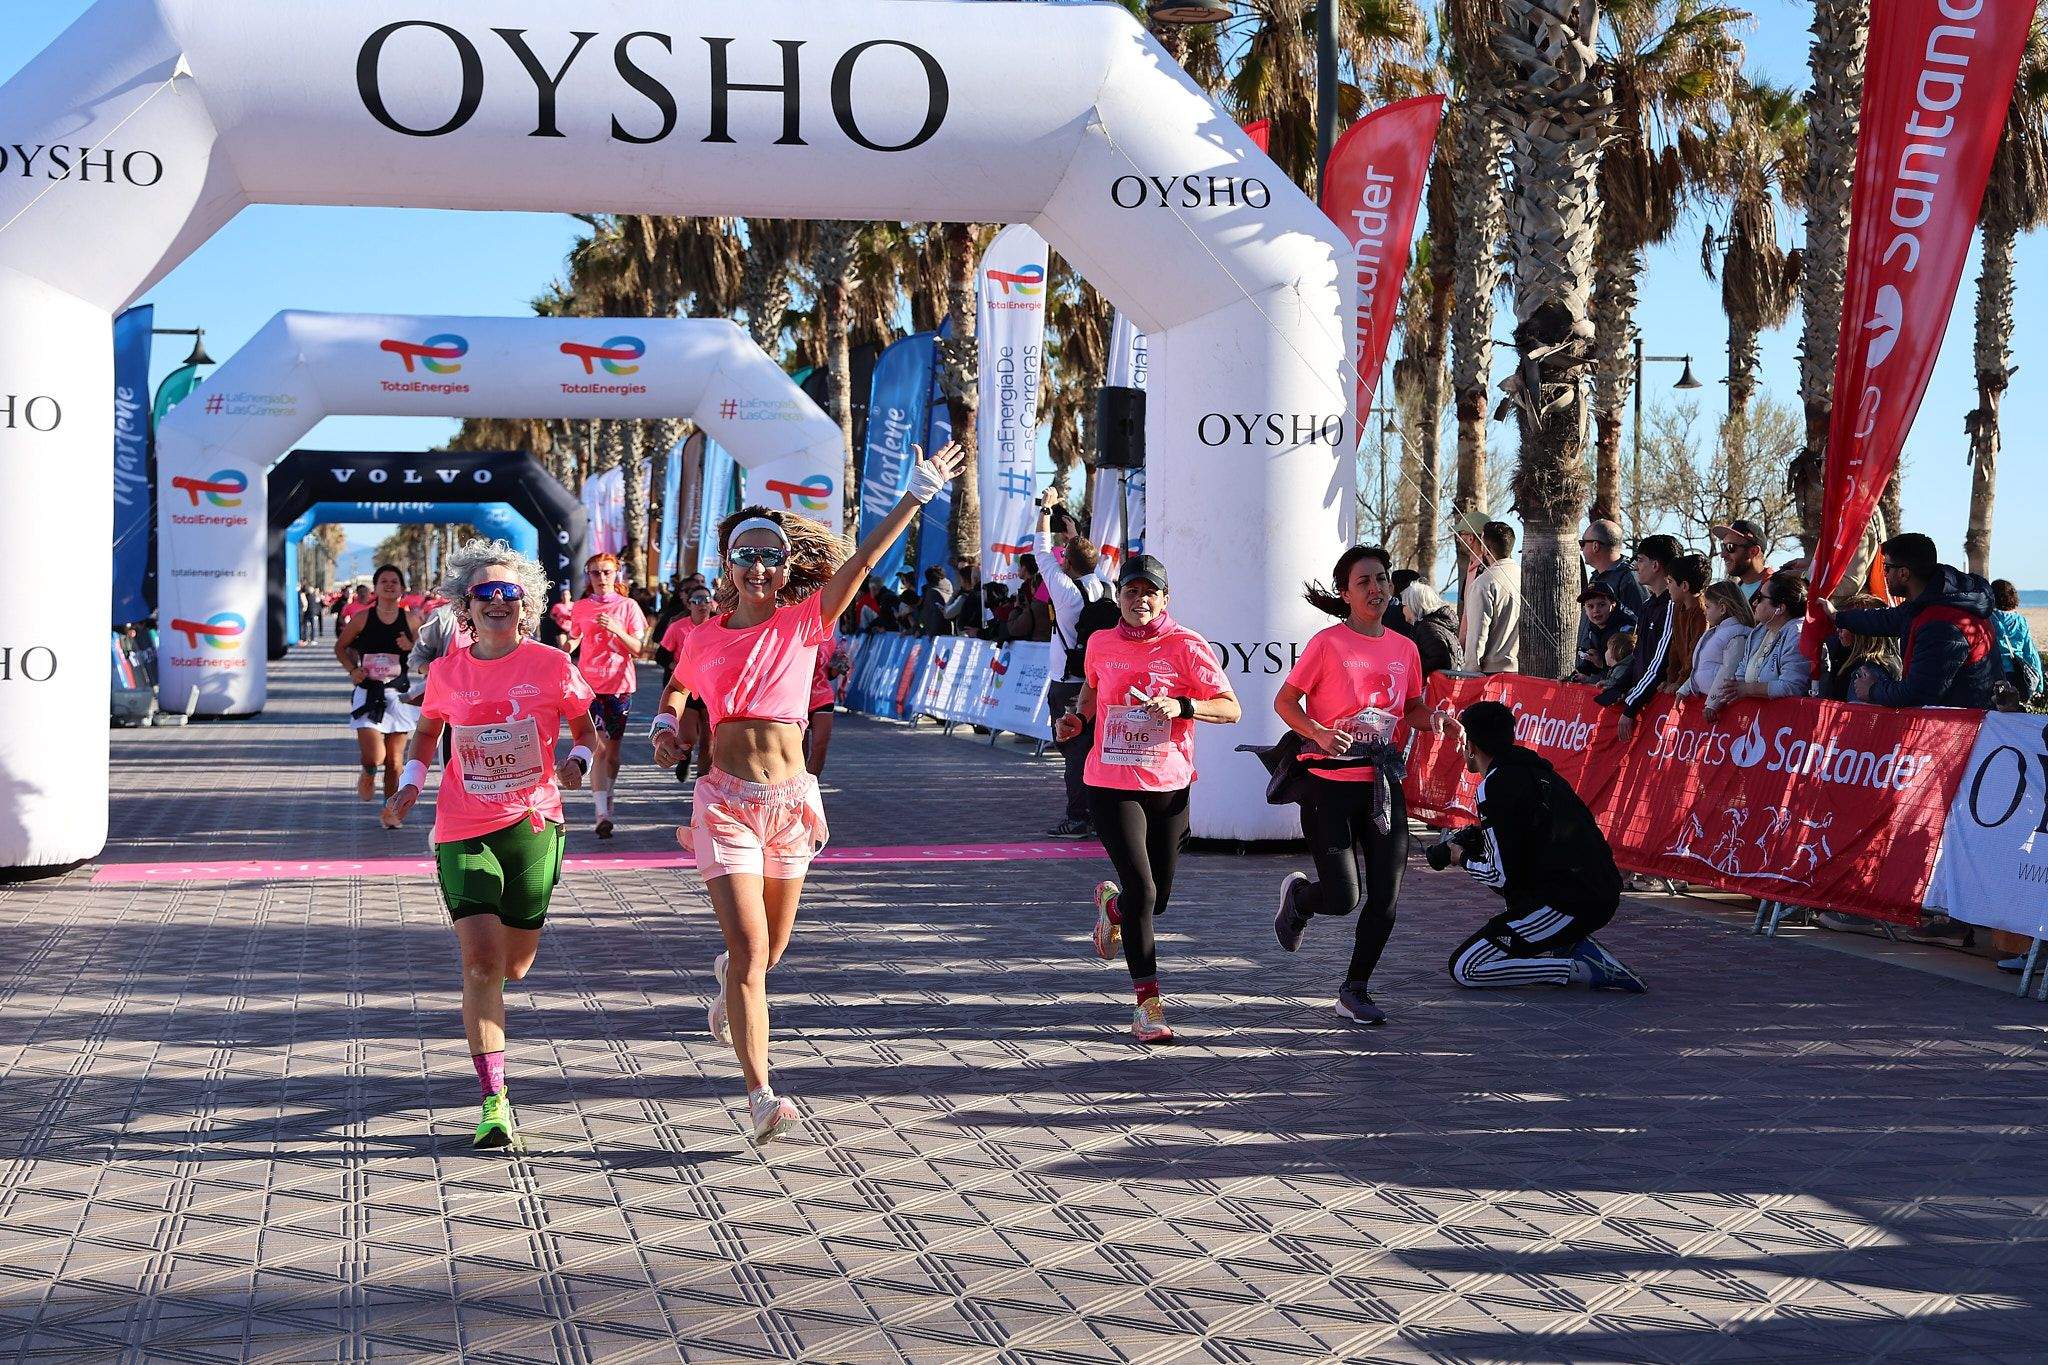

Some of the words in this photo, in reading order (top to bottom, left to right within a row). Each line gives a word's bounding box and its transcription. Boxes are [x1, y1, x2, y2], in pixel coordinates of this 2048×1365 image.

[356, 20, 949, 152] OYSHO
[0, 144, 163, 188] YSHO
[1111, 175, 1271, 209] OYSHO
[987, 301, 1042, 310] TotalEnergie
[380, 380, 470, 395] TotalEnergies
[560, 382, 647, 395] TotalEnergies
[1198, 413, 1344, 448] OYSHO
[330, 468, 493, 484] VOLVO
[171, 514, 249, 528] TotalEnergies
[170, 656, 248, 669] TotalEnergies
[1125, 731, 1149, 742] 016
[485, 753, 516, 767] 016
[1648, 714, 1731, 770] Sports
[1767, 726, 1934, 791] Santander
